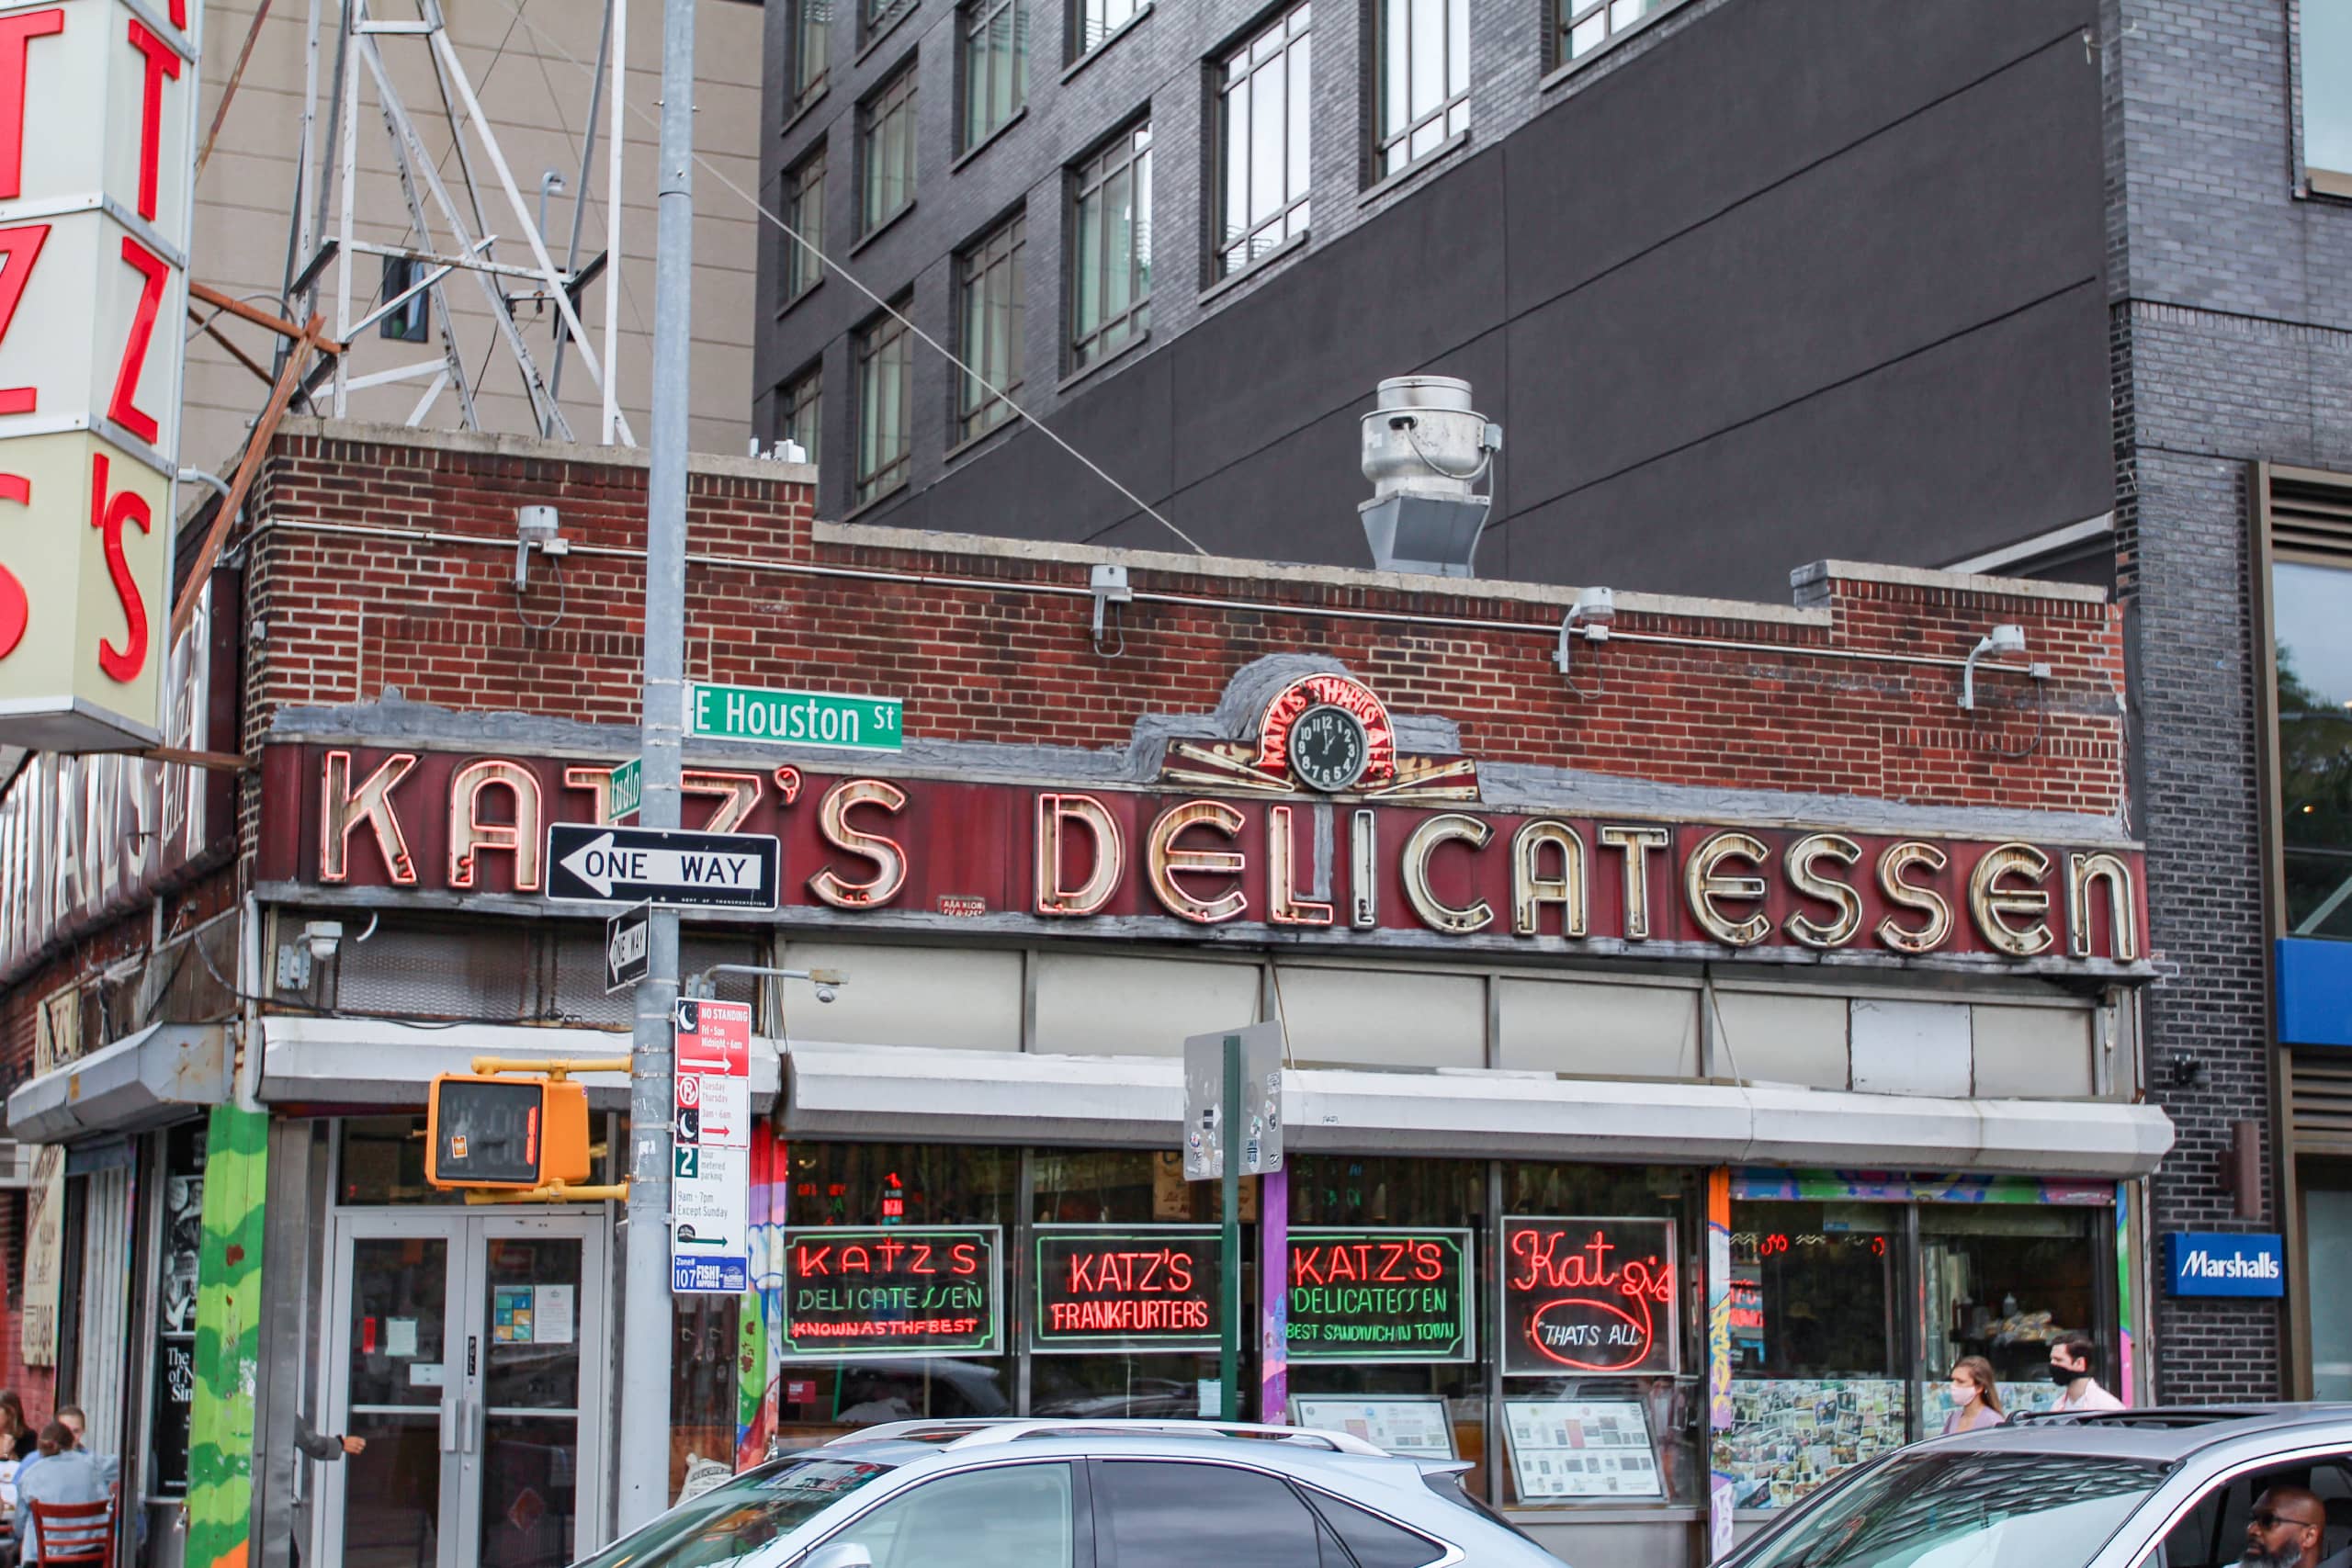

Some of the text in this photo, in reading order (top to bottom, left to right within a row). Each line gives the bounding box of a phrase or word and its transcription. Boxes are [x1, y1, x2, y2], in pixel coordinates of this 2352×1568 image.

[696, 691, 895, 742] E Houston St
[1322, 716, 1332, 729] 12
[1313, 719, 1320, 731] 11
[1338, 720, 1342, 733] 1
[1301, 728, 1311, 740] 10
[1344, 729, 1351, 742] 2
[1298, 740, 1306, 754] 9
[1348, 744, 1355, 757] 3
[1302, 756, 1310, 770] 8
[1342, 758, 1351, 772] 4
[1312, 765, 1319, 779] 7
[1323, 770, 1330, 783] 6
[1334, 766, 1341, 780] 5
[611, 766, 640, 814] Ludlo
[585, 851, 747, 884] ONE WAY
[613, 923, 644, 966] ONE WAY
[701, 1008, 748, 1021] NO STANDING
[701, 1024, 710, 1035] Fri
[701, 1037, 743, 1050] Midnight 6am
[702, 1081, 726, 1092] Tuesday
[702, 1092, 729, 1103] Thursday
[680, 1146, 694, 1176] 2
[701, 1160, 726, 1170] metered
[701, 1172, 723, 1182] parking
[677, 1190, 713, 1203] 9am 7pm
[677, 1205, 728, 1219] Except Sunday
[1294, 1238, 1443, 1287] KATZ'S
[2181, 1249, 2279, 1279] Marshalls
[1071, 1247, 1193, 1293] KATZ'S
[675, 1269, 696, 1288] 107
[798, 1286, 983, 1311] DELICATESSEN
[1294, 1287, 1447, 1314] DELICATESSEN
[1051, 1300, 1209, 1331] FRANKFURTERS
[1286, 1322, 1454, 1342] BEST SANDWICH IN TOWN
[1608, 1324, 1640, 1346] ALL
[167, 1347, 189, 1367] The
[168, 1367, 182, 1383] of
[172, 1383, 194, 1403] Sin
